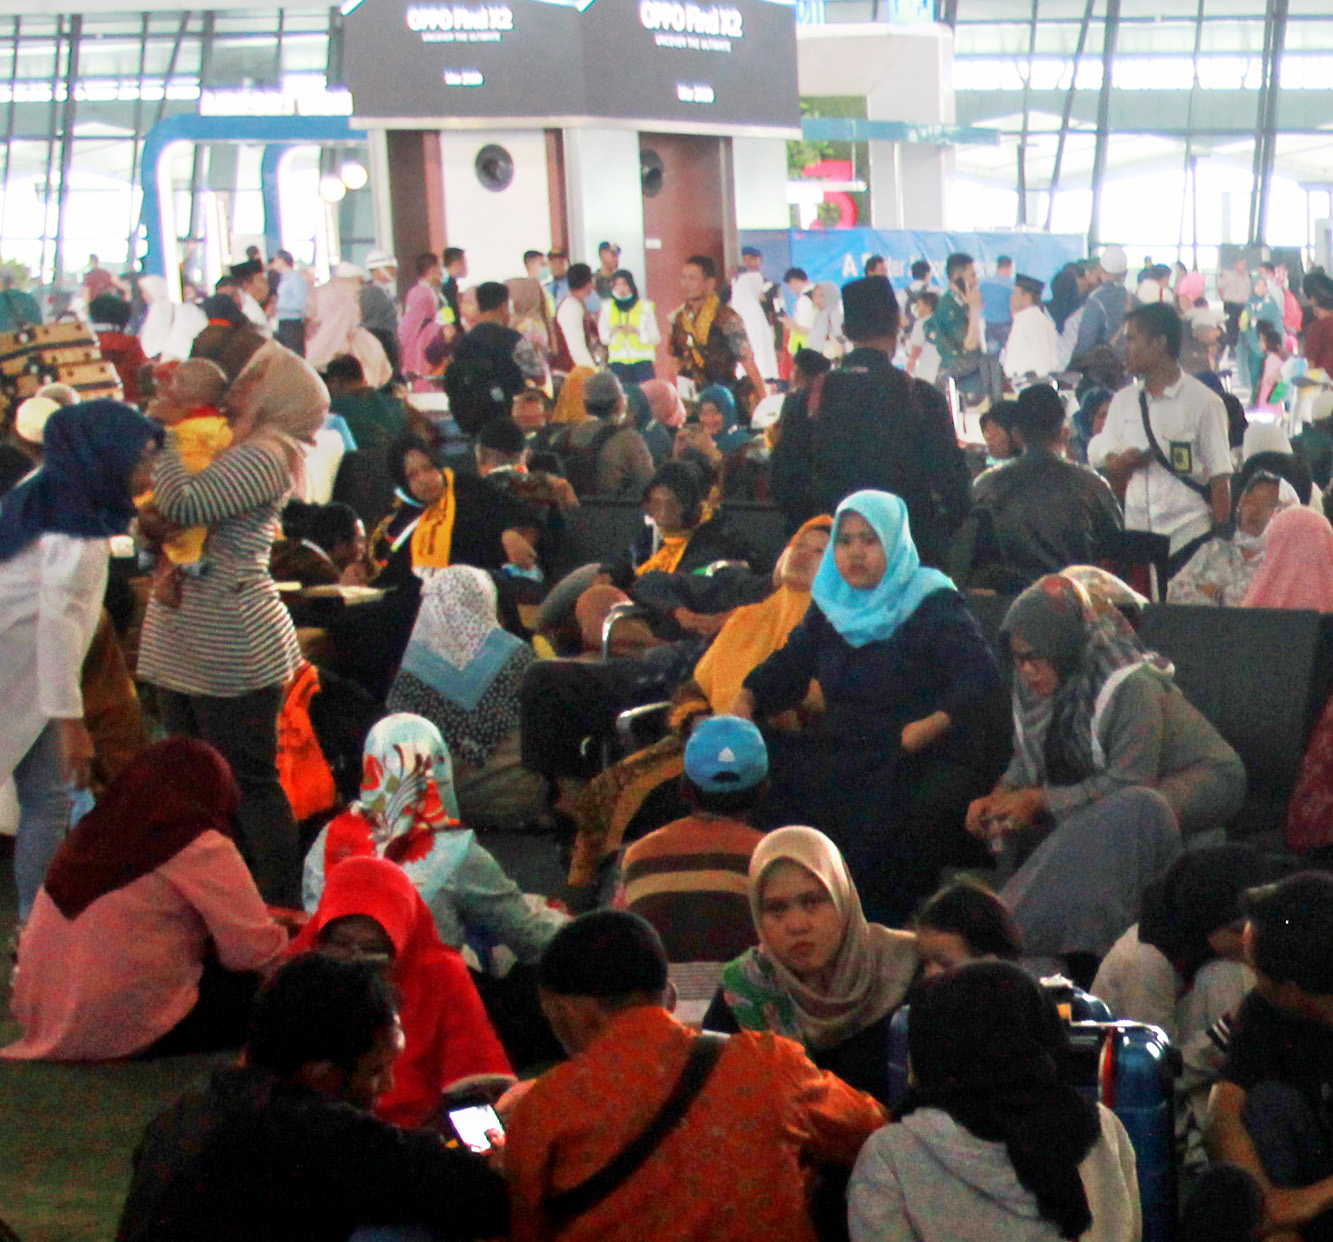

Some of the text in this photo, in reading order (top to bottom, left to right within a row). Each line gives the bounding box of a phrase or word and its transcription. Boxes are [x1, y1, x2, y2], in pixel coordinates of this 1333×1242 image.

[406, 6, 514, 31] OPPO Find X2
[640, 1, 743, 38] OPPO Find X2
